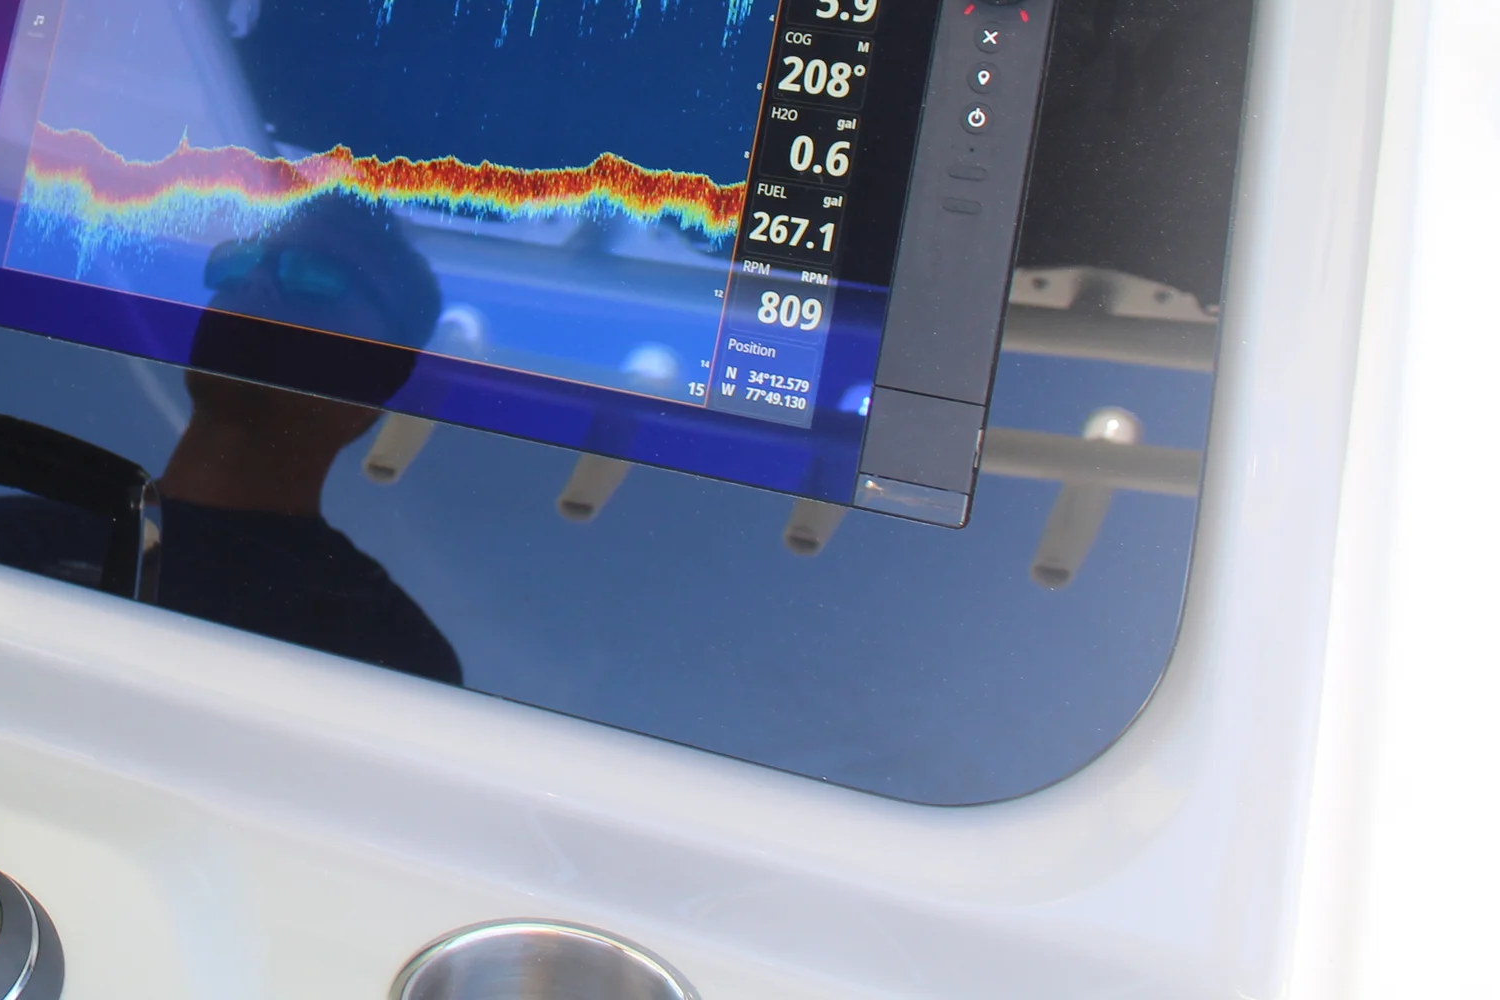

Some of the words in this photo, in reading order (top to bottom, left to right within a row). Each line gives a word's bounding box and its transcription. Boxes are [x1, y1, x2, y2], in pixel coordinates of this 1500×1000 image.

[768, 14, 775, 22] 4
[785, 31, 813, 46] COG
[857, 40, 870, 53] M
[756, 82, 762, 91] 6
[777, 55, 867, 99] 208°
[771, 106, 798, 122] H2O
[837, 116, 856, 131] gal
[744, 150, 750, 159] 8
[789, 135, 852, 178] 0.6
[757, 183, 787, 200] FUEL
[823, 194, 843, 210] gal
[748, 211, 836, 253] 267.1
[743, 260, 771, 276] RPM
[801, 271, 828, 286] RPM
[714, 289, 724, 298] 12
[757, 290, 823, 331] 809
[728, 338, 776, 358] Position
[700, 359, 710, 369] 14
[687, 381, 705, 397] 15
[725, 366, 737, 380] N
[748, 370, 810, 393] 34°12.579
[721, 383, 736, 397] W
[745, 387, 806, 410] 77°49.130
